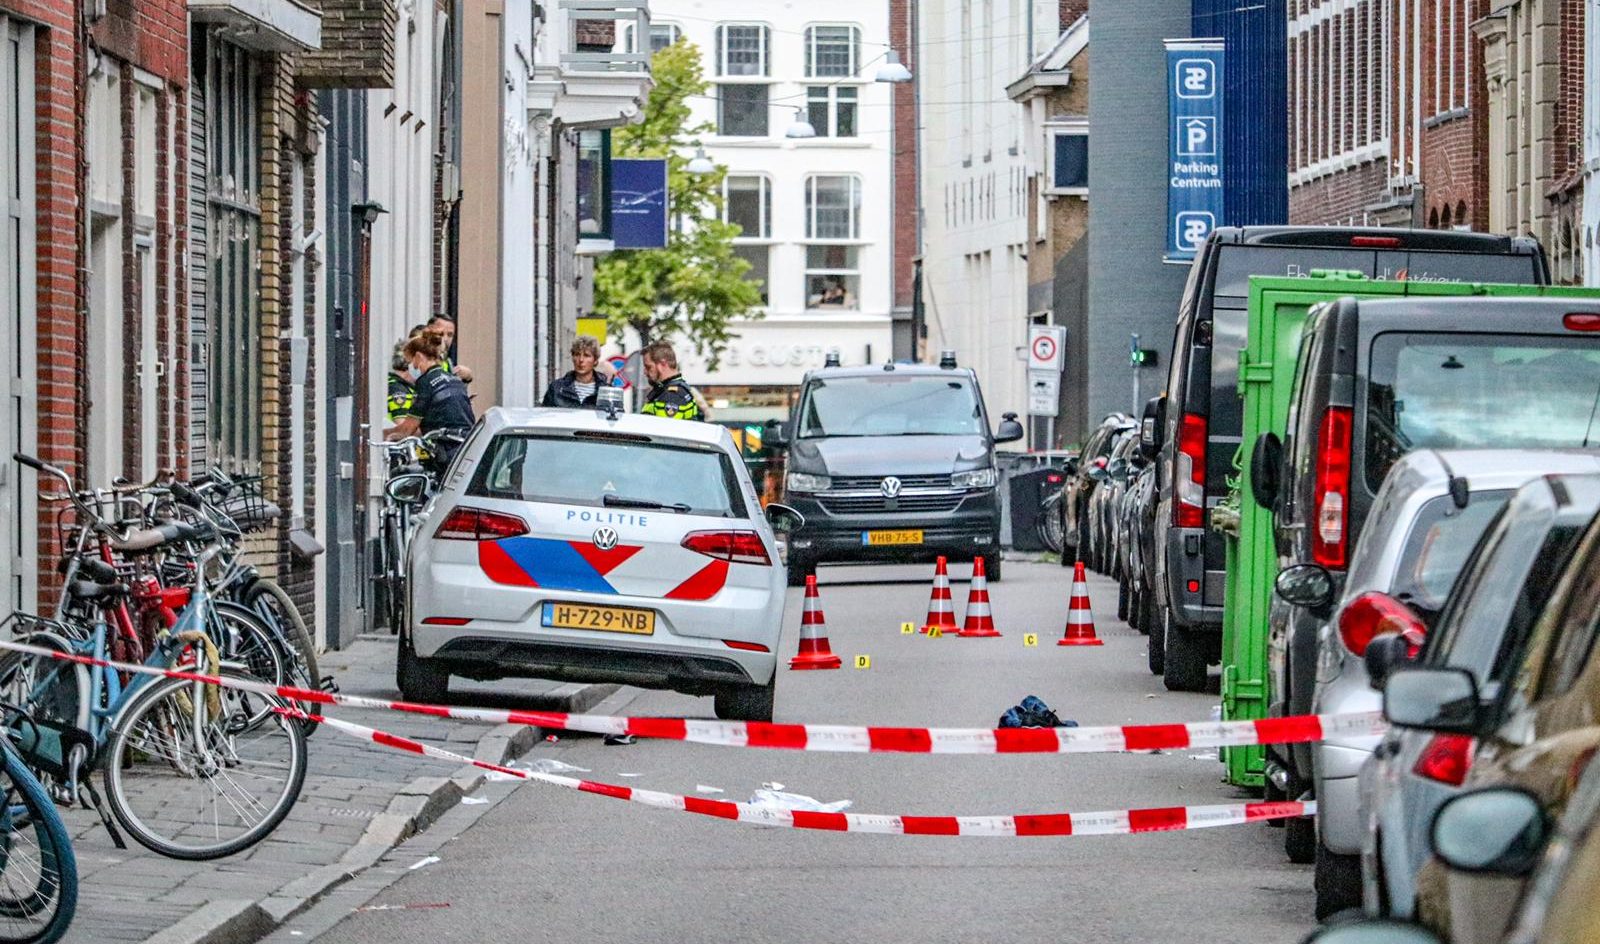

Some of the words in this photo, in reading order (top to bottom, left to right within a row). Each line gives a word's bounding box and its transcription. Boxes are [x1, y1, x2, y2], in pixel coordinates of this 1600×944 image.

[1174, 161, 1218, 176] Parking
[1170, 176, 1221, 188] Centrum
[566, 510, 648, 527] POLITIE
[558, 606, 648, 630] H-729-NB
[904, 623, 911, 632] A
[1027, 635, 1034, 645] C
